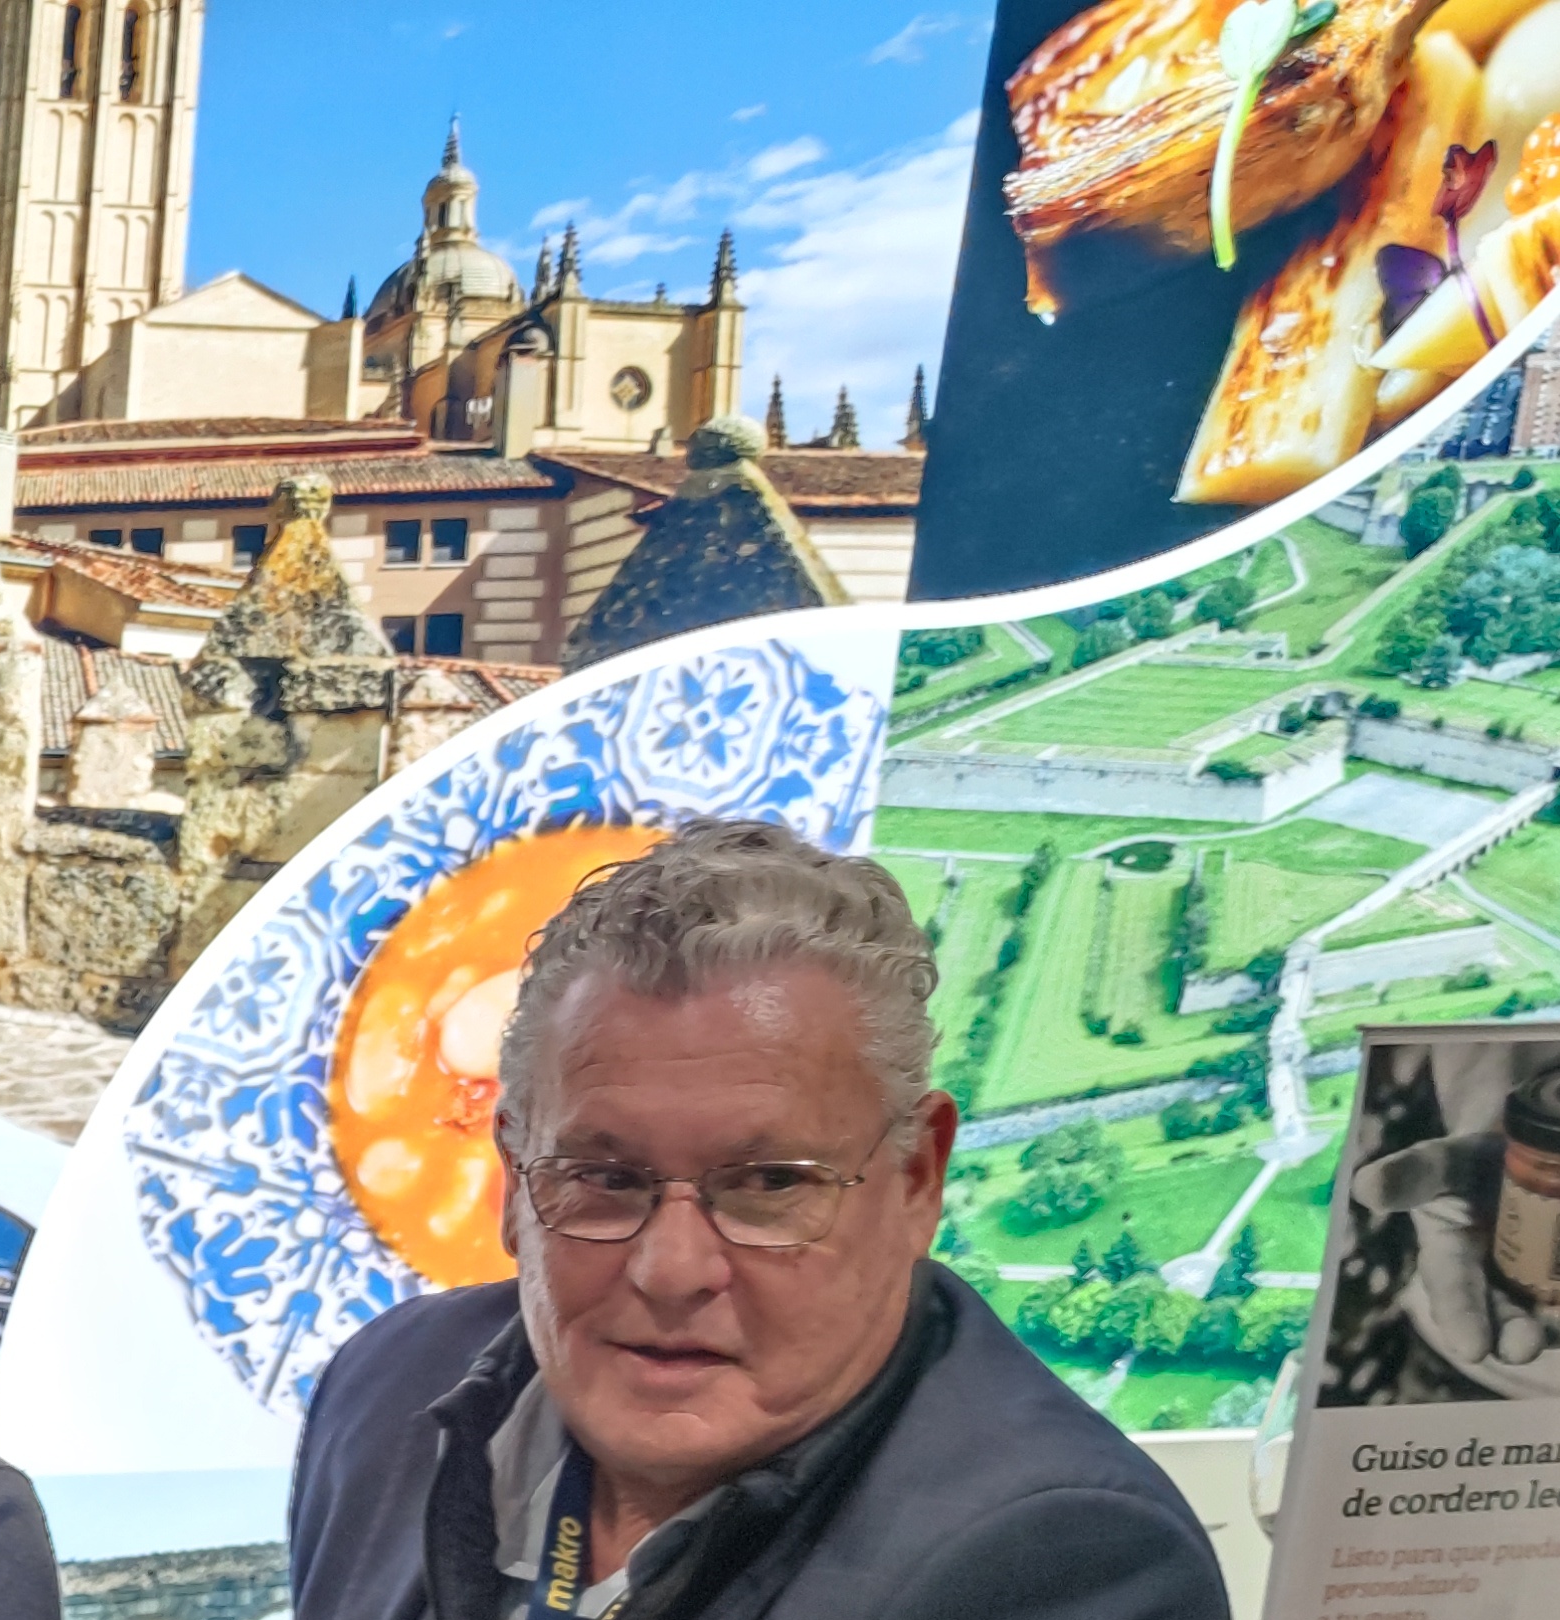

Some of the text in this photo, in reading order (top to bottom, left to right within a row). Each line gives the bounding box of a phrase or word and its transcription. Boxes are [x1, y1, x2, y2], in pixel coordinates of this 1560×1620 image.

[1351, 1438, 1560, 1473] Guiso de ma
[1342, 1480, 1560, 1518] de cordero le
[545, 1516, 583, 1612] makro
[1390, 1548, 1444, 1571] para
[1448, 1546, 1490, 1568] que
